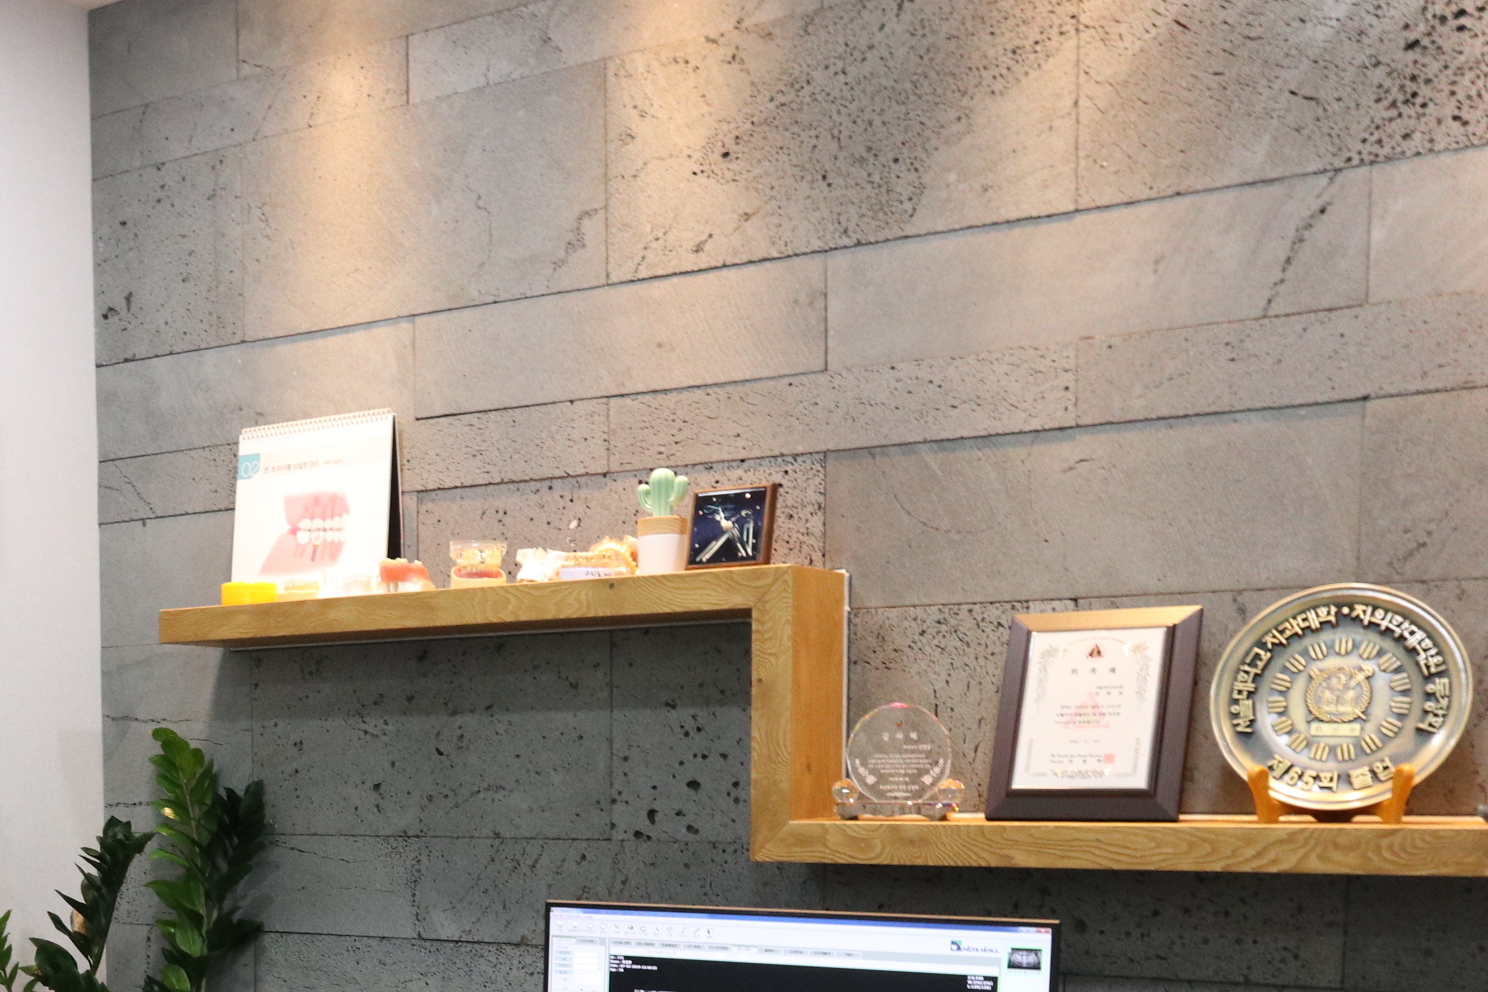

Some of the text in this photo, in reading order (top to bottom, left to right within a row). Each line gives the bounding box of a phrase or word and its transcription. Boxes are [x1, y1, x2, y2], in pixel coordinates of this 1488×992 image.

[242, 461, 260, 477] 02
[1230, 646, 1273, 733] 서울대학교
[1266, 754, 1339, 792] 제65회
